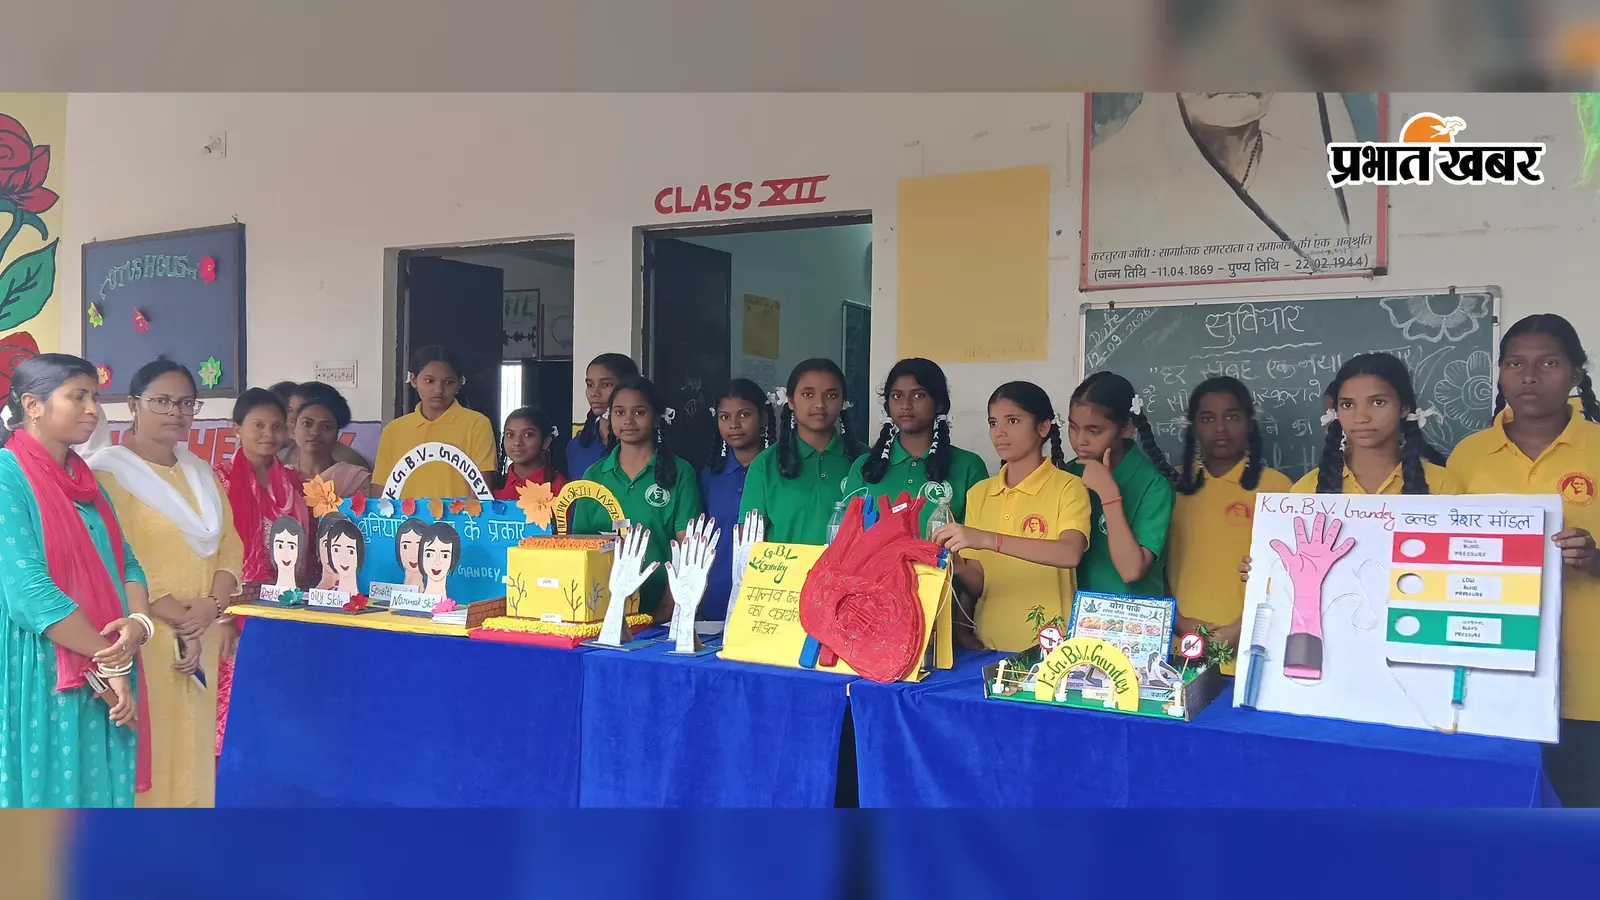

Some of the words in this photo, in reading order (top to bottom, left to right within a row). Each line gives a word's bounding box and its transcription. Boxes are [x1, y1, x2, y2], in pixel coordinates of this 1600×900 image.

[654, 181, 753, 215] CLASS
[758, 174, 831, 208] XII
[1159, 244, 1200, 258] सामाजिक
[1203, 242, 1243, 255] समरसता
[1094, 268, 1121, 281] (जन्म
[1124, 264, 1148, 278] तिथि
[1228, 262, 1251, 278] पुण्य
[1254, 257, 1280, 272] तिथि
[463, 511, 481, 541] के
[488, 519, 526, 542] प्रकार
[1488, 510, 1535, 529] मॉडल
[457, 565, 501, 584] GANDEY
[747, 586, 788, 602] मानव
[748, 604, 765, 617] का
[1109, 601, 1124, 611] योग
[1126, 604, 1141, 613] पार्क
